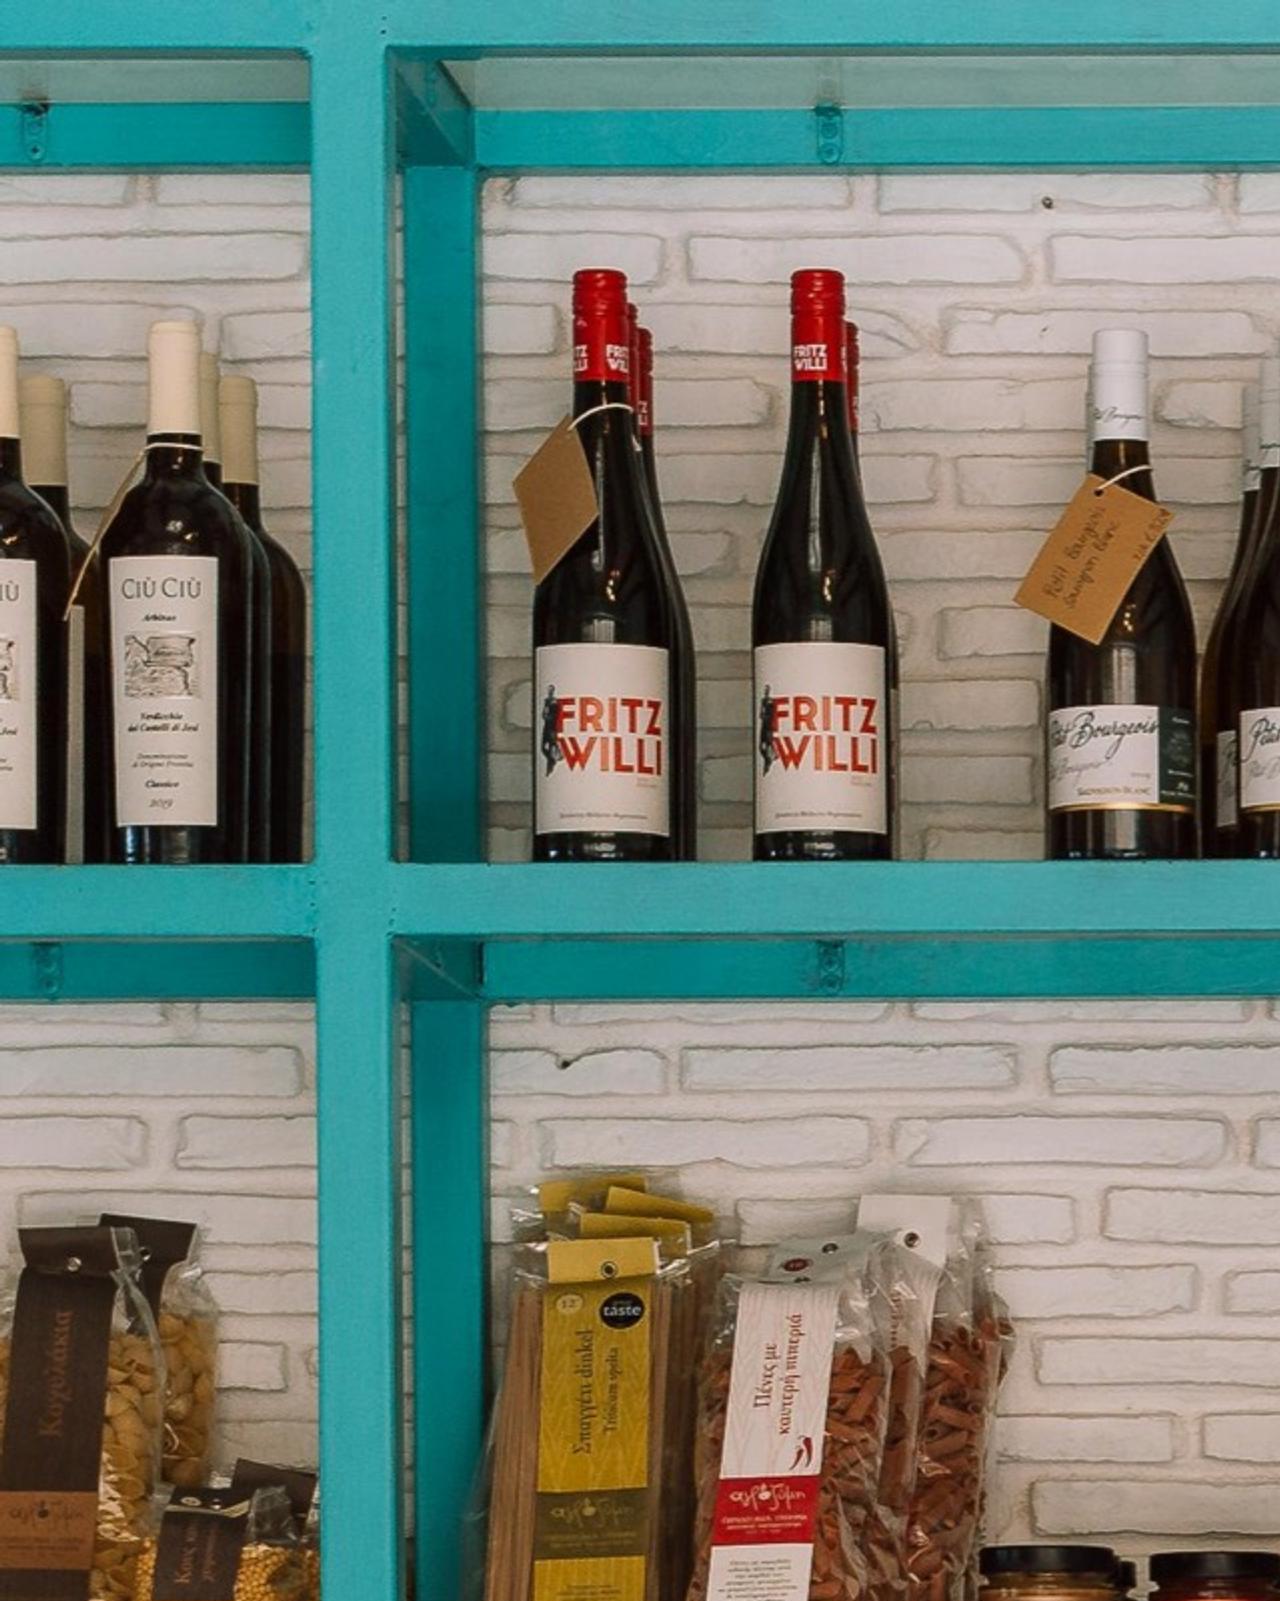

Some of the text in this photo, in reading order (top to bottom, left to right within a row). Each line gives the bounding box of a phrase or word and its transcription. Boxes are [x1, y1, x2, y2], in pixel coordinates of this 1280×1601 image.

[557, 697, 663, 735] FRITZ
[773, 697, 879, 735] FRITZ
[557, 735, 663, 777] WILLI
[773, 735, 879, 776] WILLI
